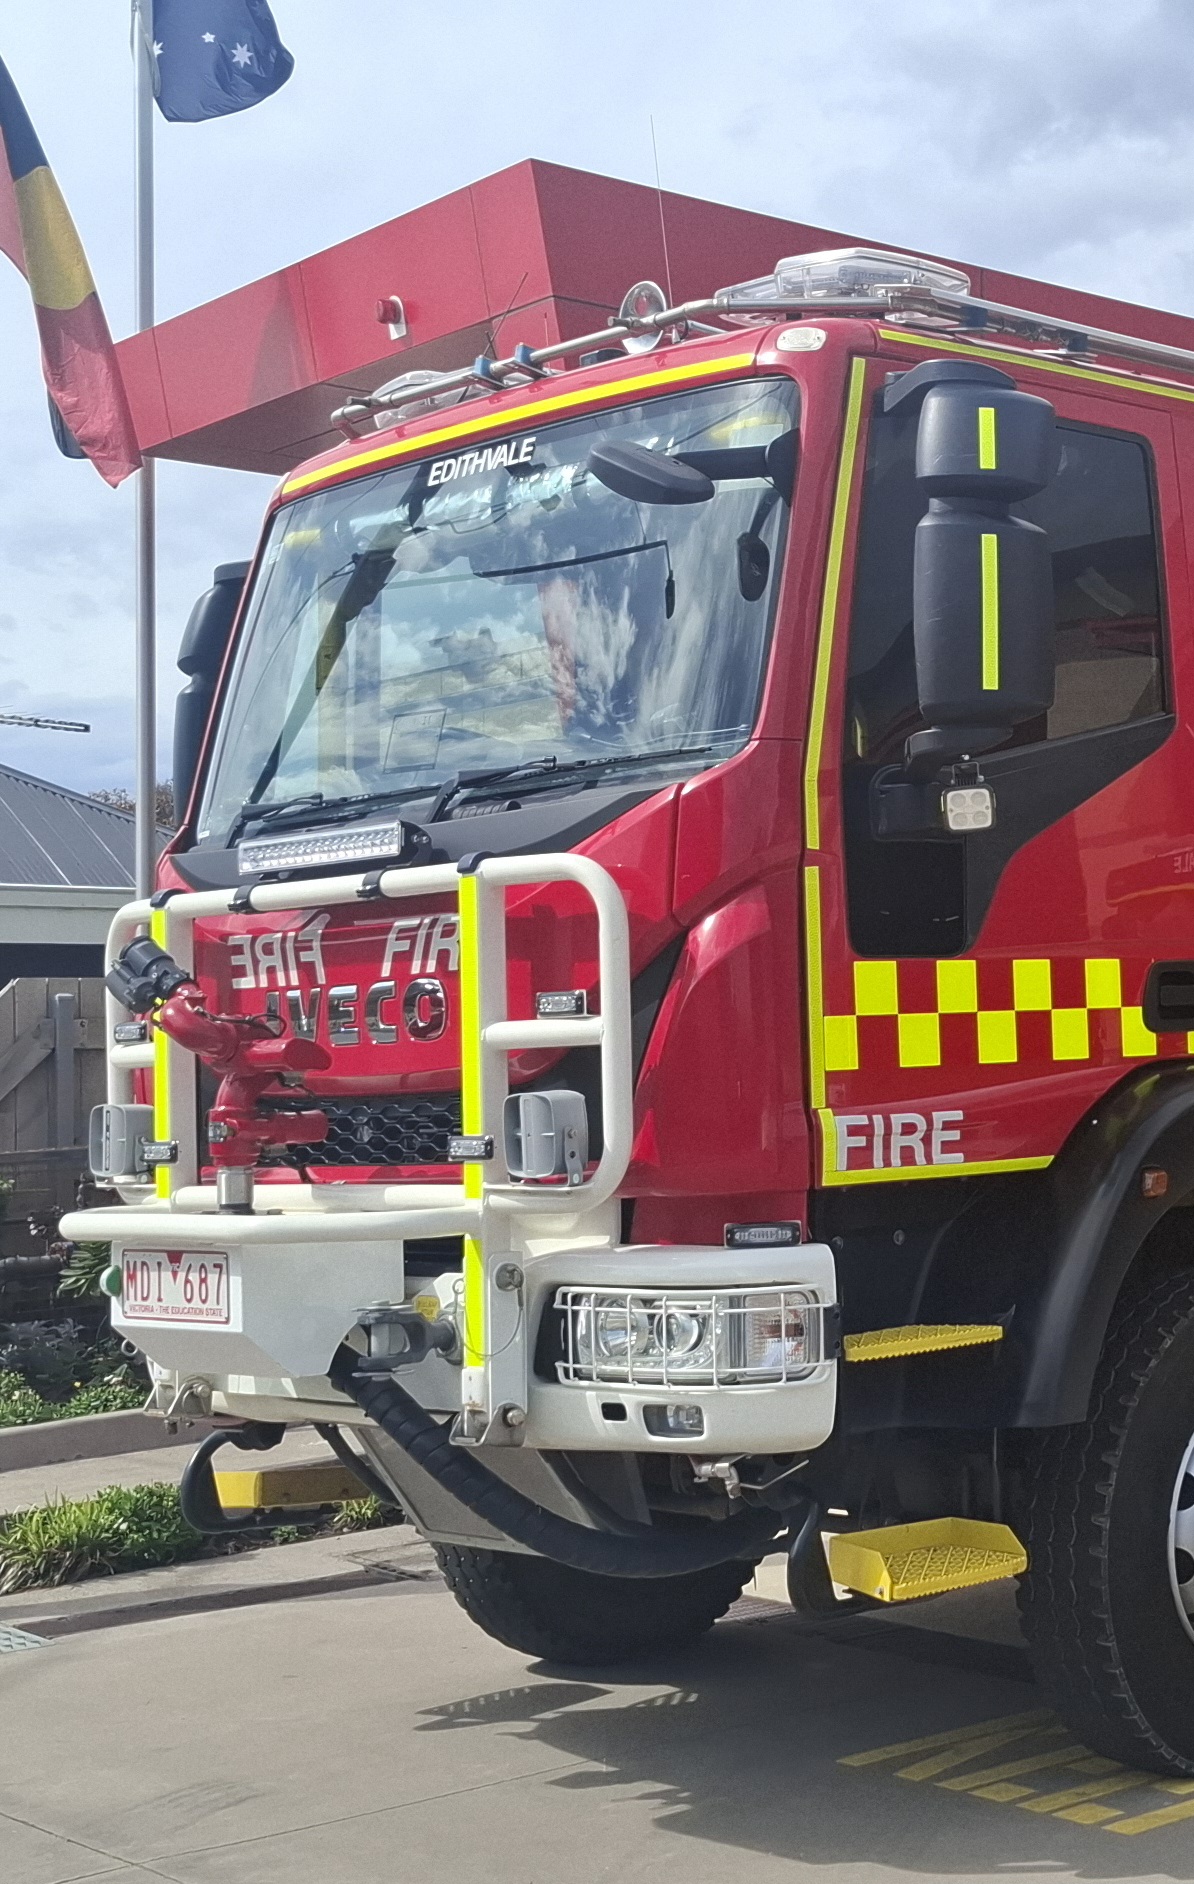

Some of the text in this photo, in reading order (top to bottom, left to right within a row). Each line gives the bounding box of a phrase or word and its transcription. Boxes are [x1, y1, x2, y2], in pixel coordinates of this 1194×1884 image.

[427, 437, 536, 486] EDITHVALE
[381, 914, 460, 977] FIR
[266, 978, 448, 1046] IVECO
[834, 1110, 965, 1171] FIRE
[159, 1305, 170, 1315] THE
[183, 1262, 224, 1306] 687
